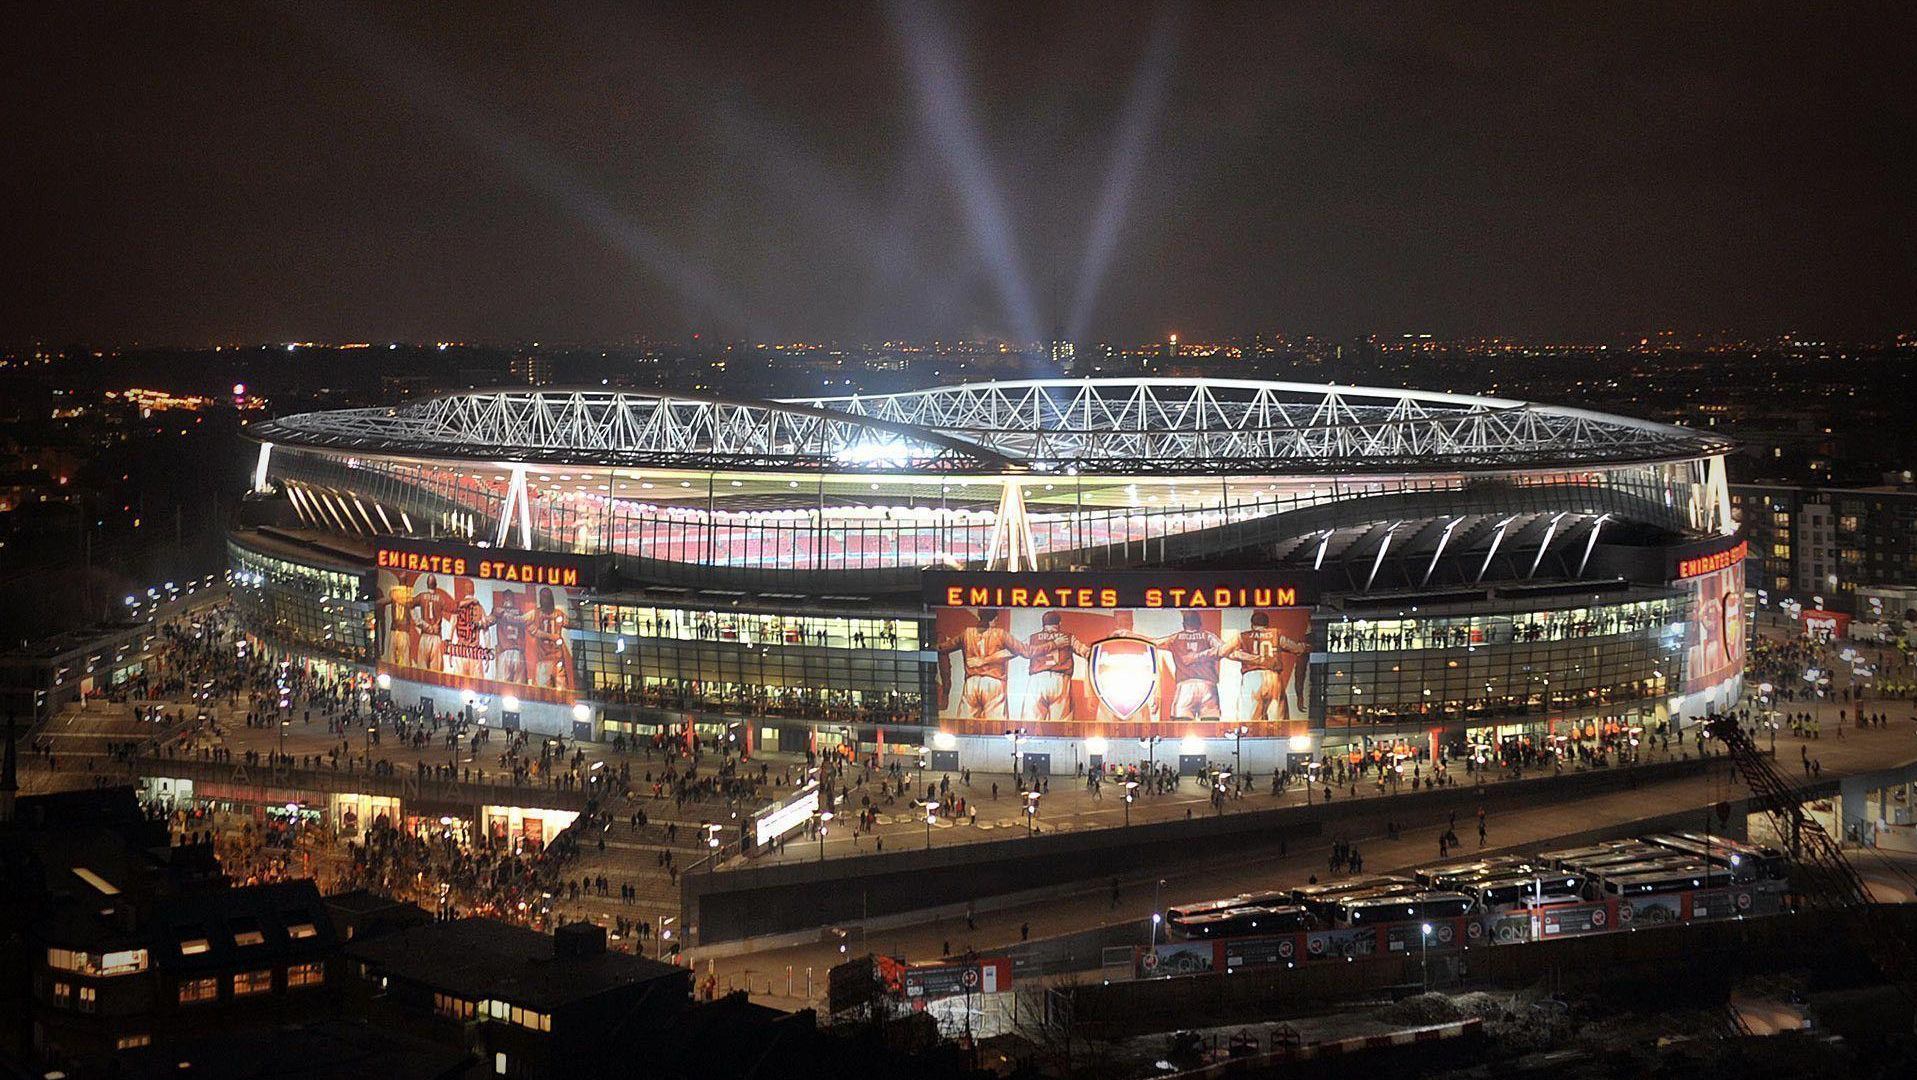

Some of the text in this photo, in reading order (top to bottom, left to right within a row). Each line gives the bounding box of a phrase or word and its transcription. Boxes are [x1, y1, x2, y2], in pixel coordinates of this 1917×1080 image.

[378, 549, 577, 586] EMIRATES STADIUM
[1679, 551, 1731, 578] EMIRATES
[947, 587, 1296, 607] EMIRATES STADIUM
